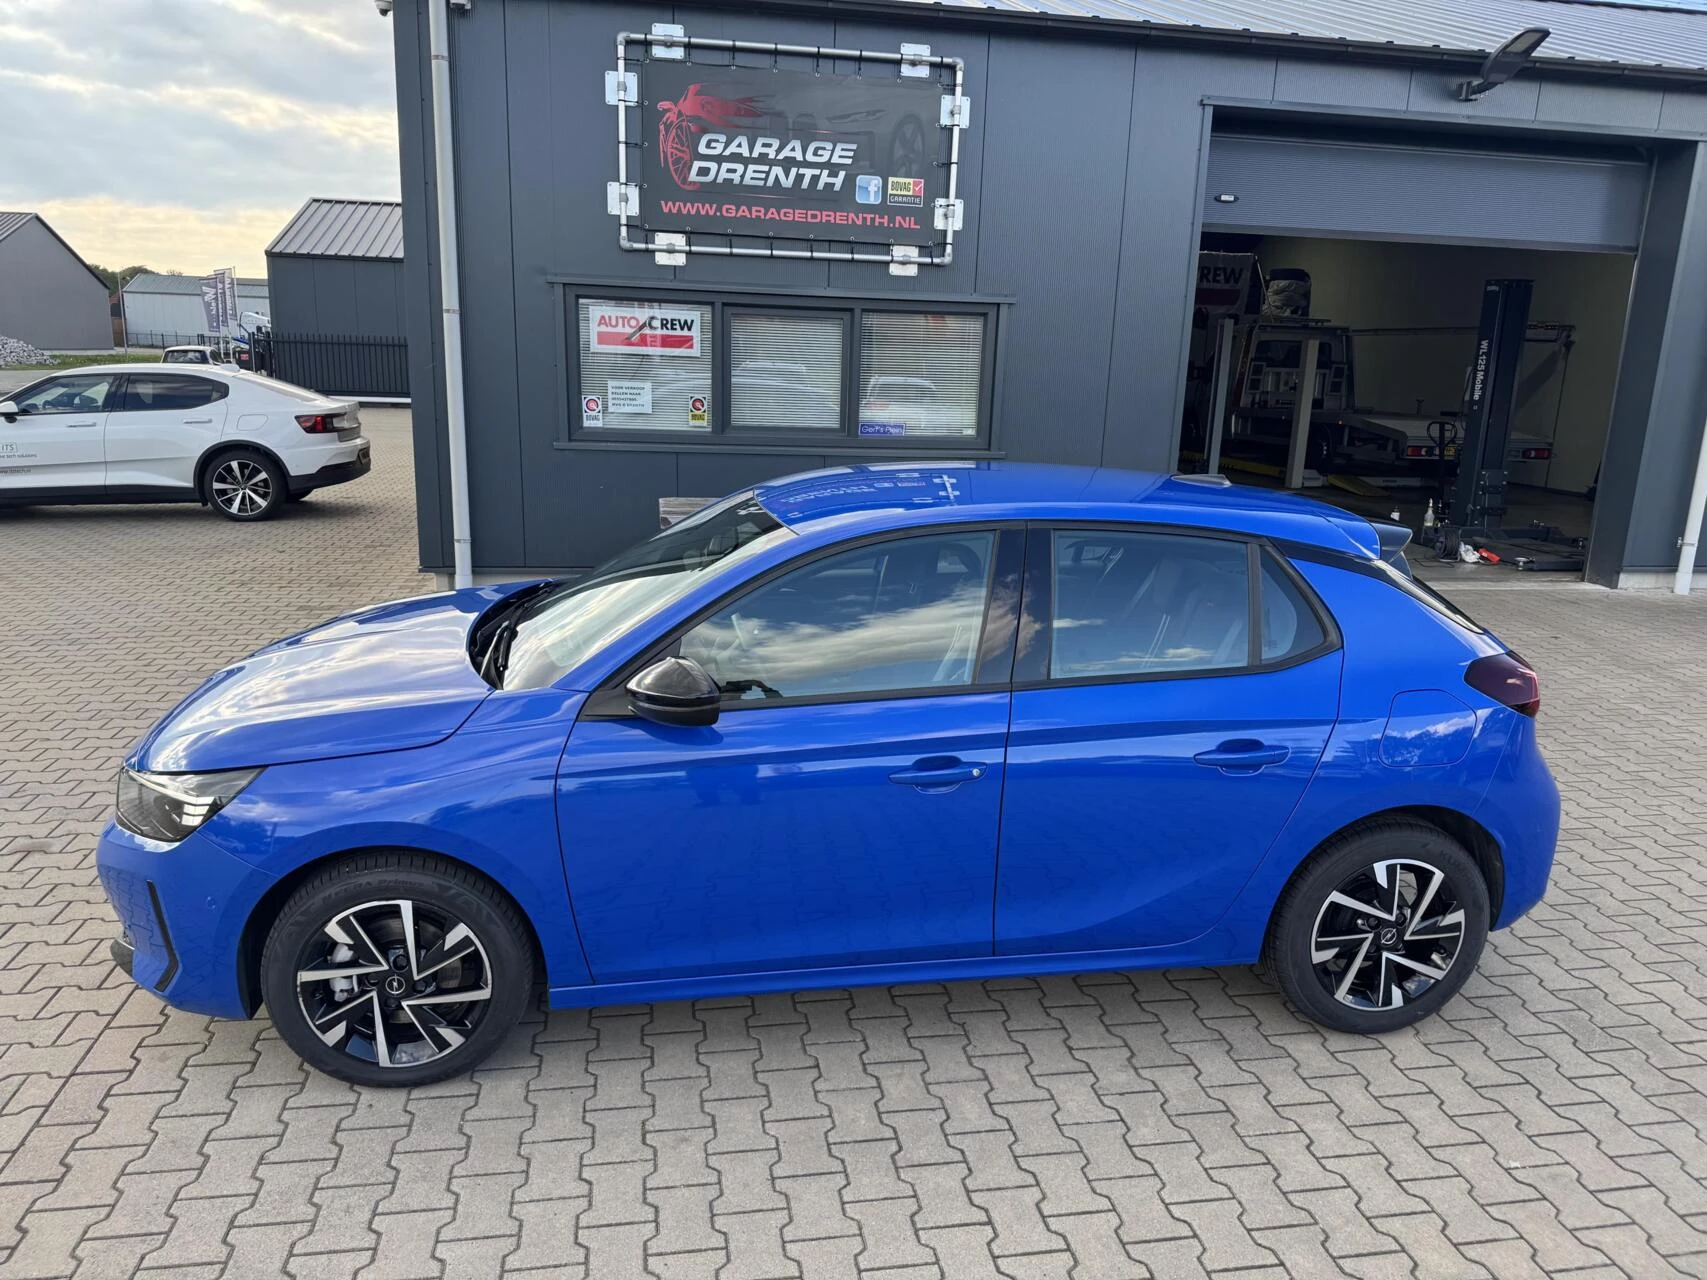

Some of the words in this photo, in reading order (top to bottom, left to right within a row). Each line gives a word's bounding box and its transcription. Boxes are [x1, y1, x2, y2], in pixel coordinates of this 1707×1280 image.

[697, 133, 858, 164] GARAGE
[687, 160, 846, 191] DRENTH
[890, 180, 912, 193] BOVAG
[889, 195, 921, 205] GARANTIE
[660, 200, 921, 229] WWW.GARAGEDRENTH.NL
[1199, 266, 1243, 284] REW
[597, 315, 640, 329] AUTO
[647, 315, 694, 332] CREW
